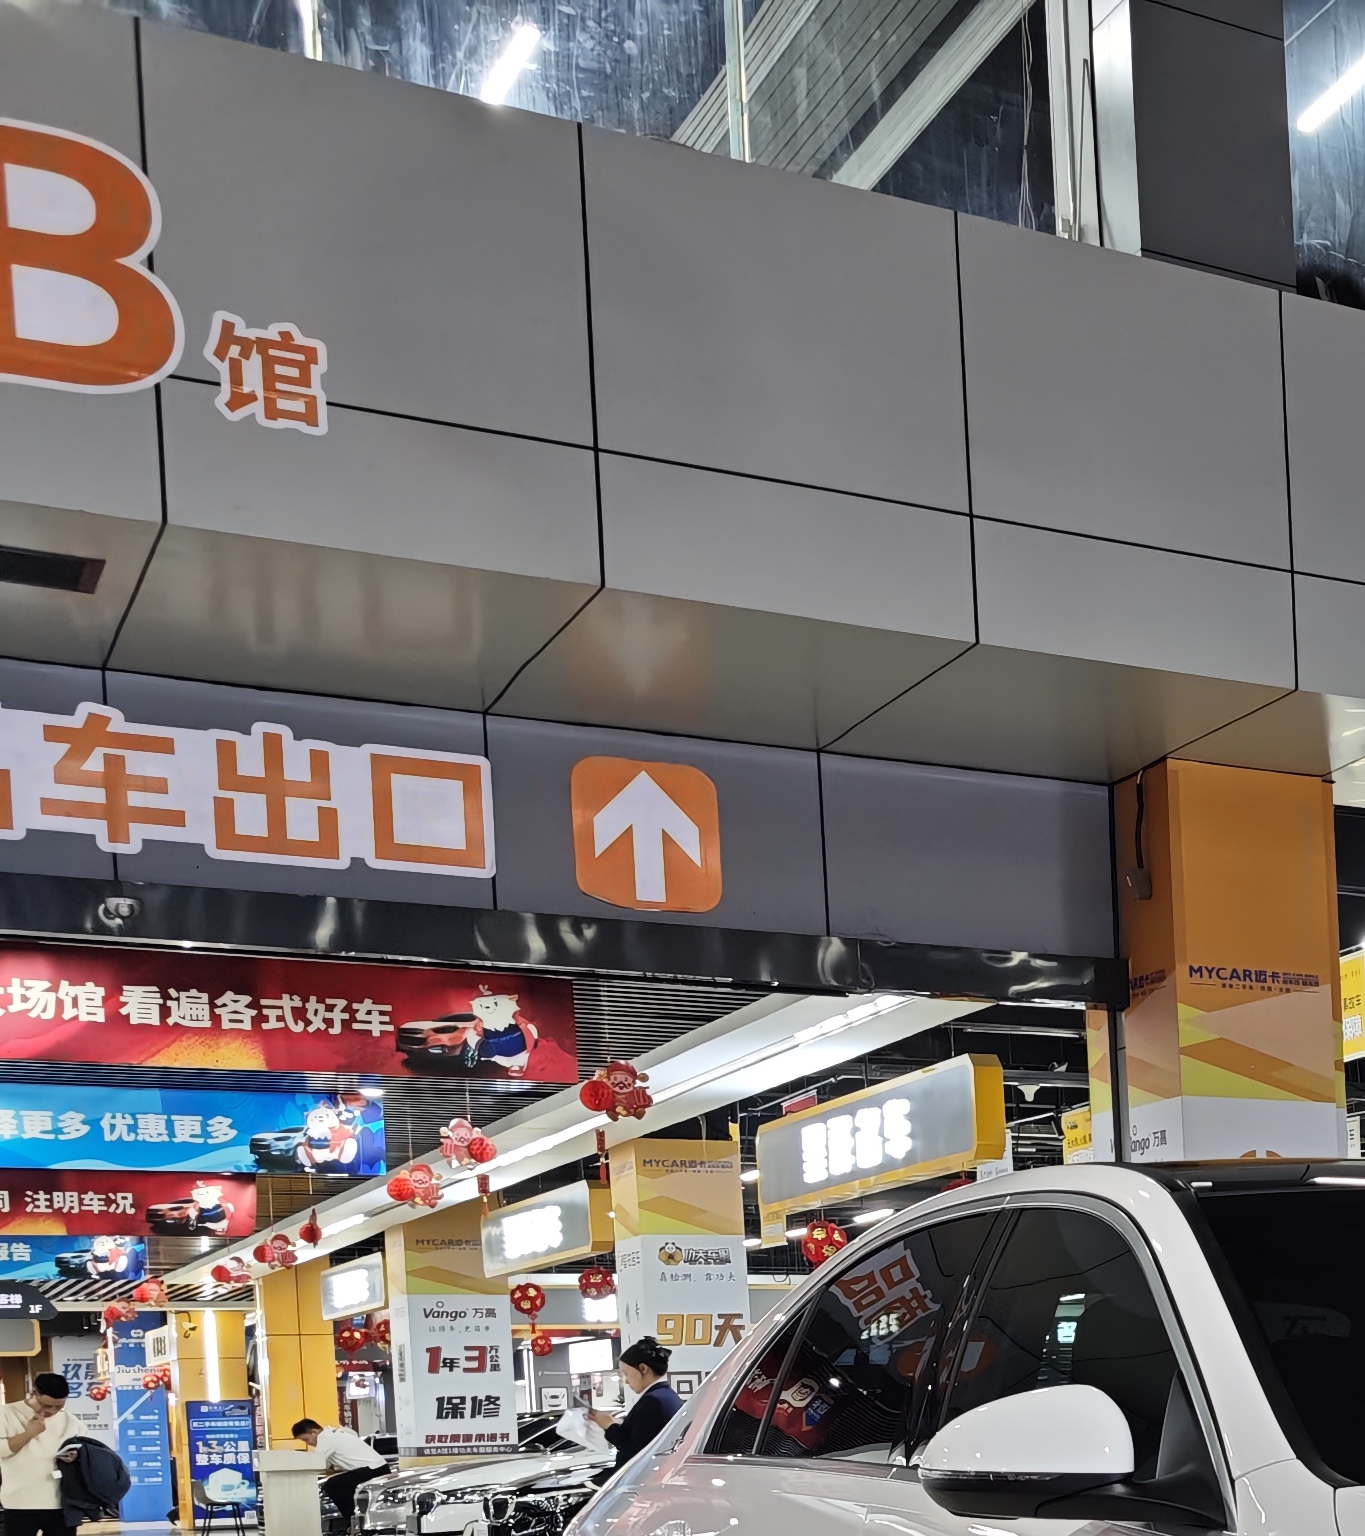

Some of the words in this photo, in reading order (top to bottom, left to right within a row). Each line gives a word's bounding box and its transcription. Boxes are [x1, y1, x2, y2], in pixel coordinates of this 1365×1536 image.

[204, 312, 328, 435] 馆
[0, 703, 495, 877] 车出口
[0, 978, 106, 1023] 场馆
[119, 985, 395, 1037] 看遍各式好车
[100, 1113, 238, 1145] 优惠更多
[24, 1190, 136, 1214] 注明车况
[29, 1304, 42, 1314] 1F
[423, 1301, 468, 1321] Vango
[657, 1313, 745, 1347] 90天
[435, 1395, 501, 1420] 保修
